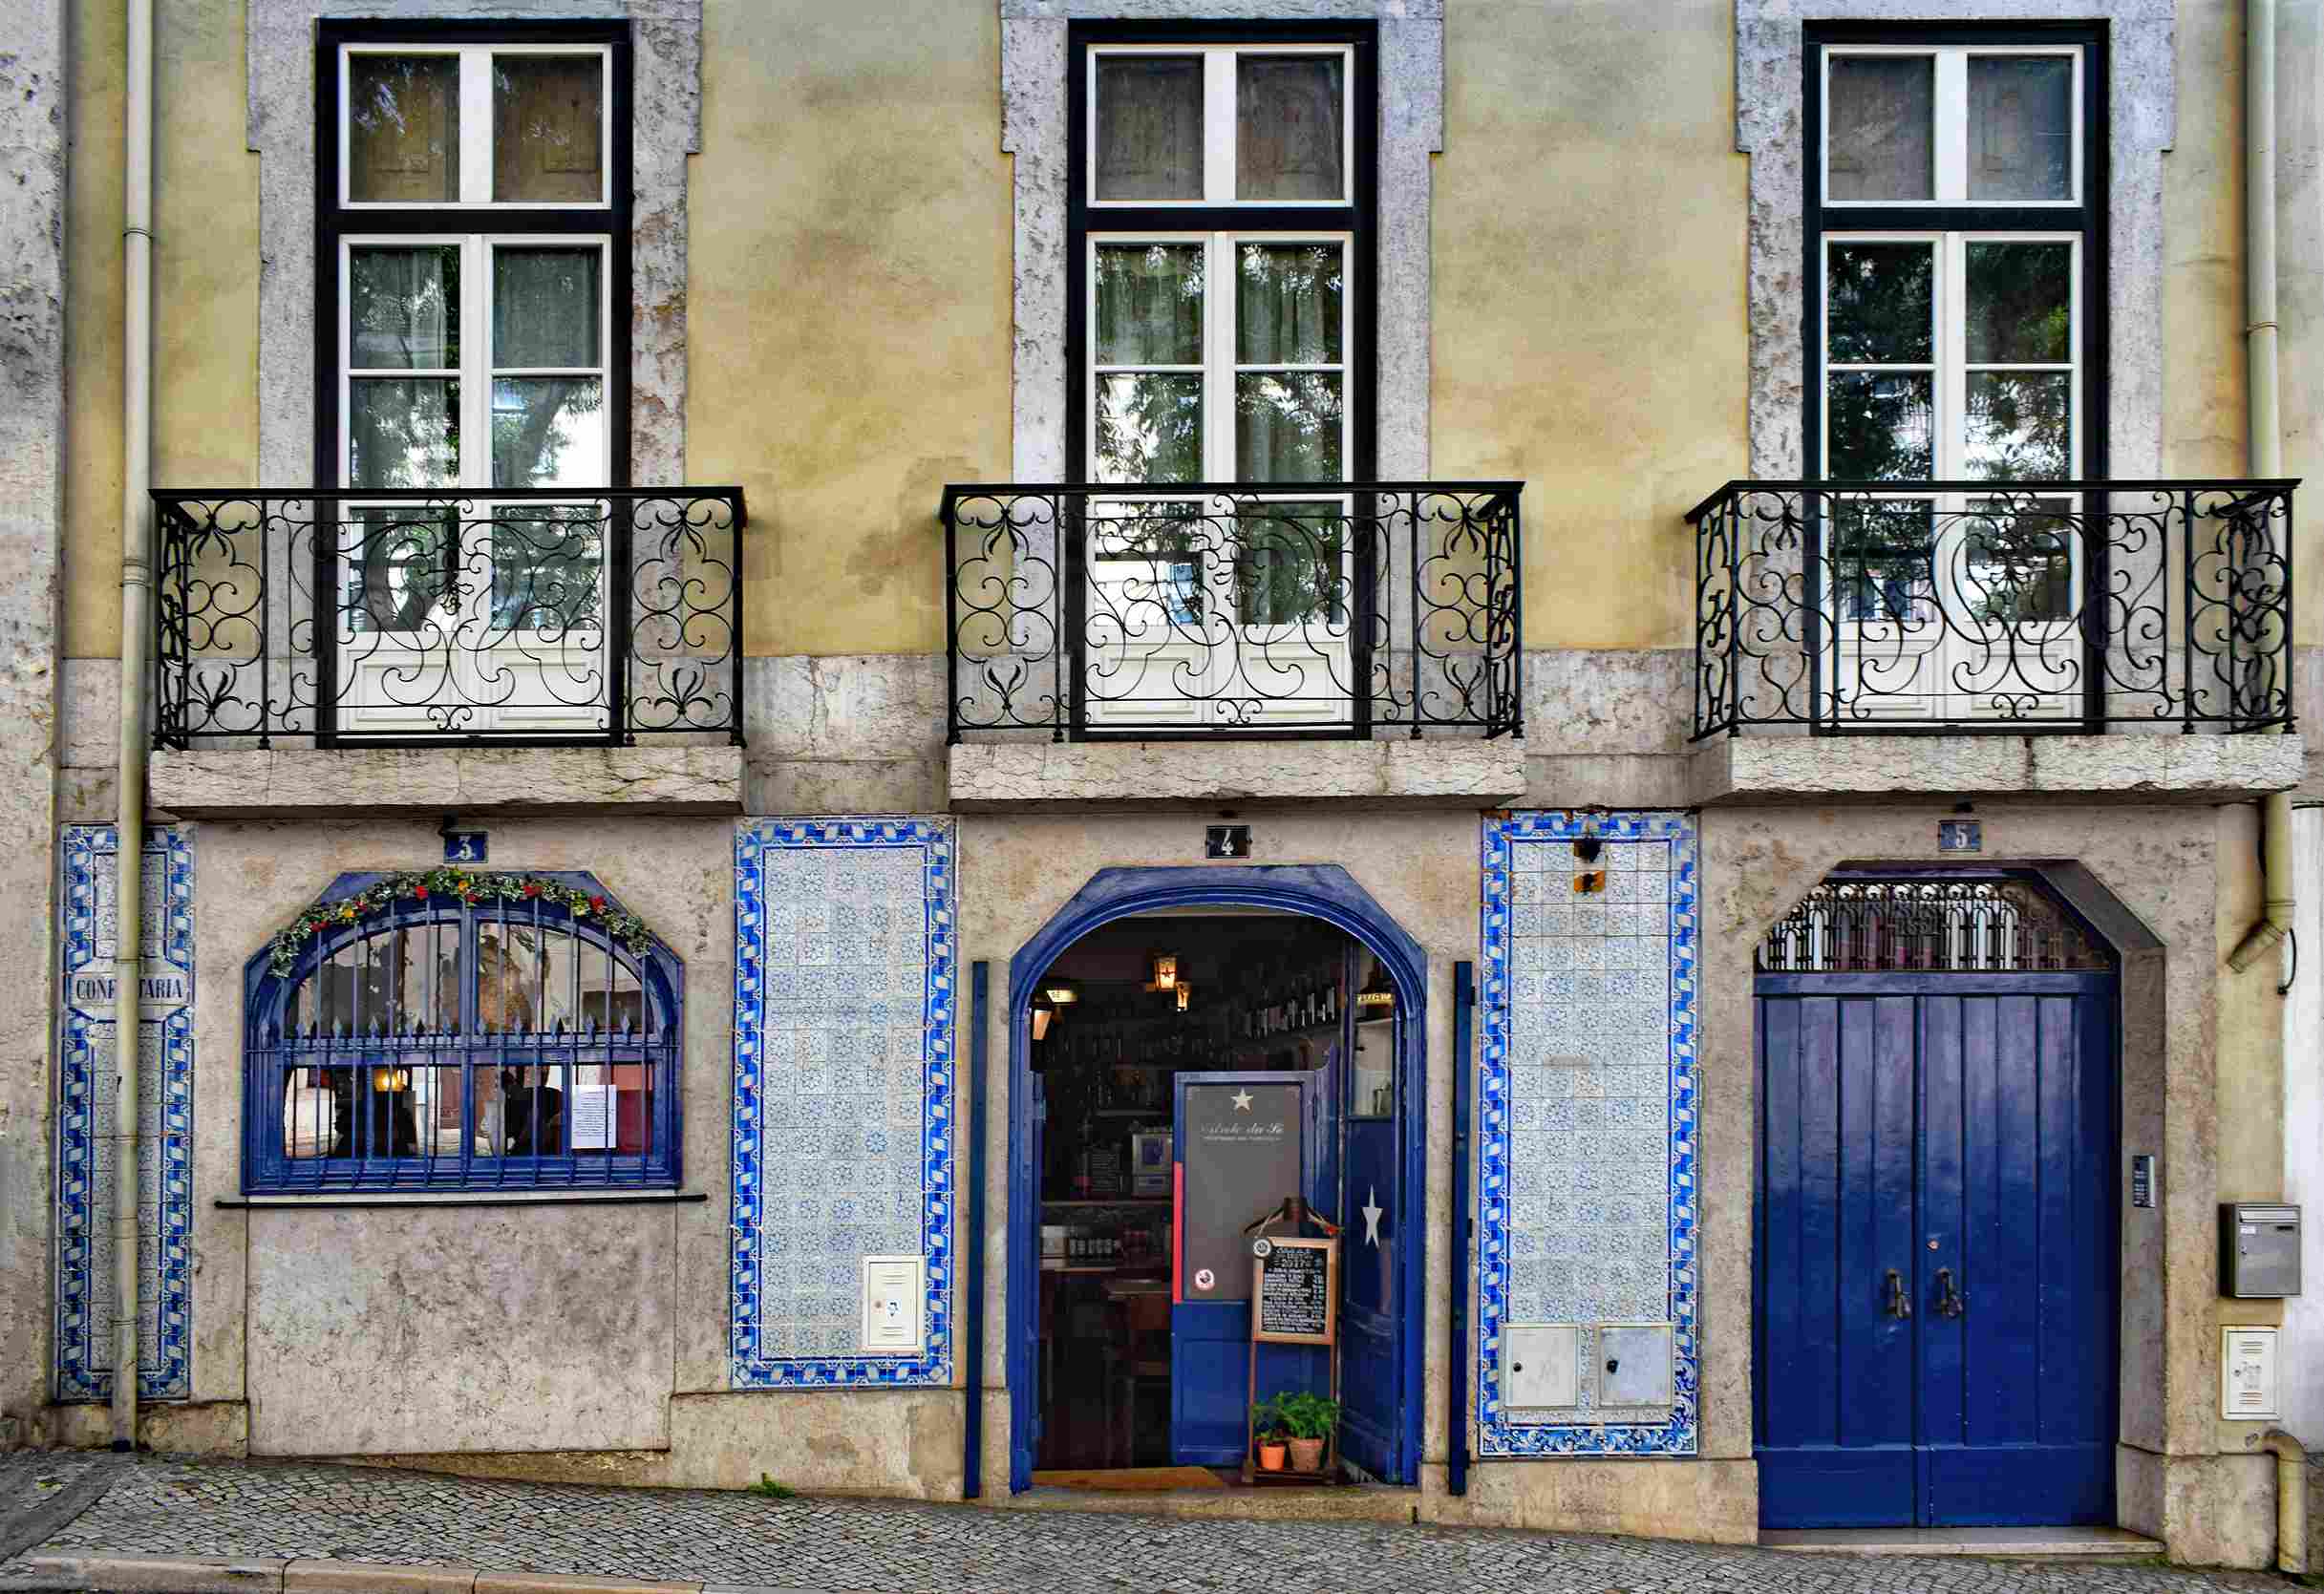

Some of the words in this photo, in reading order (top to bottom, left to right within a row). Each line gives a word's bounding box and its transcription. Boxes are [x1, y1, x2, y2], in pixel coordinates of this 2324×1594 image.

[458, 835, 473, 861] 3
[1222, 829, 1234, 856] 4
[1955, 824, 1968, 849] 5
[75, 978, 182, 1000] CONFTARIA
